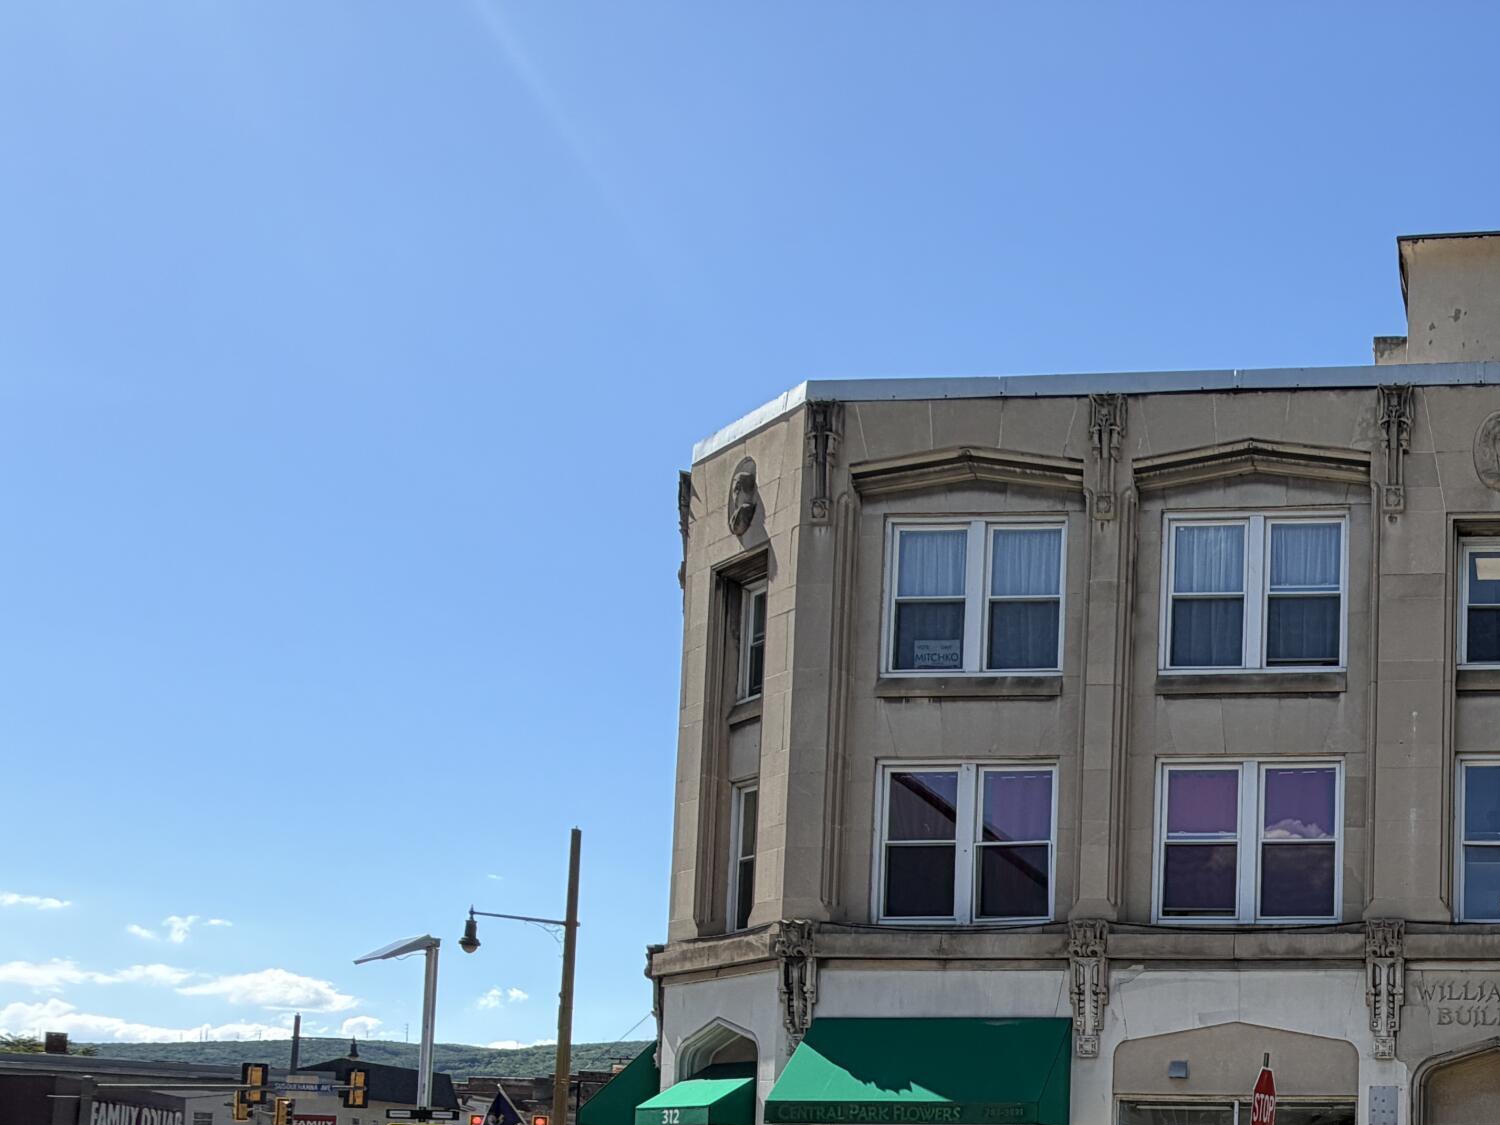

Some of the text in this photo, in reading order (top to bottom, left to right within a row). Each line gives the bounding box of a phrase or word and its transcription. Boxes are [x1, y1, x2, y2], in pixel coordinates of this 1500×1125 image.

[778, 1104, 845, 1120] CENTRAL
[849, 1104, 889, 1120] PARK
[893, 1104, 961, 1121] FLOWERS
[1253, 1093, 1274, 1123] STOP
[662, 1109, 680, 1125] 312
